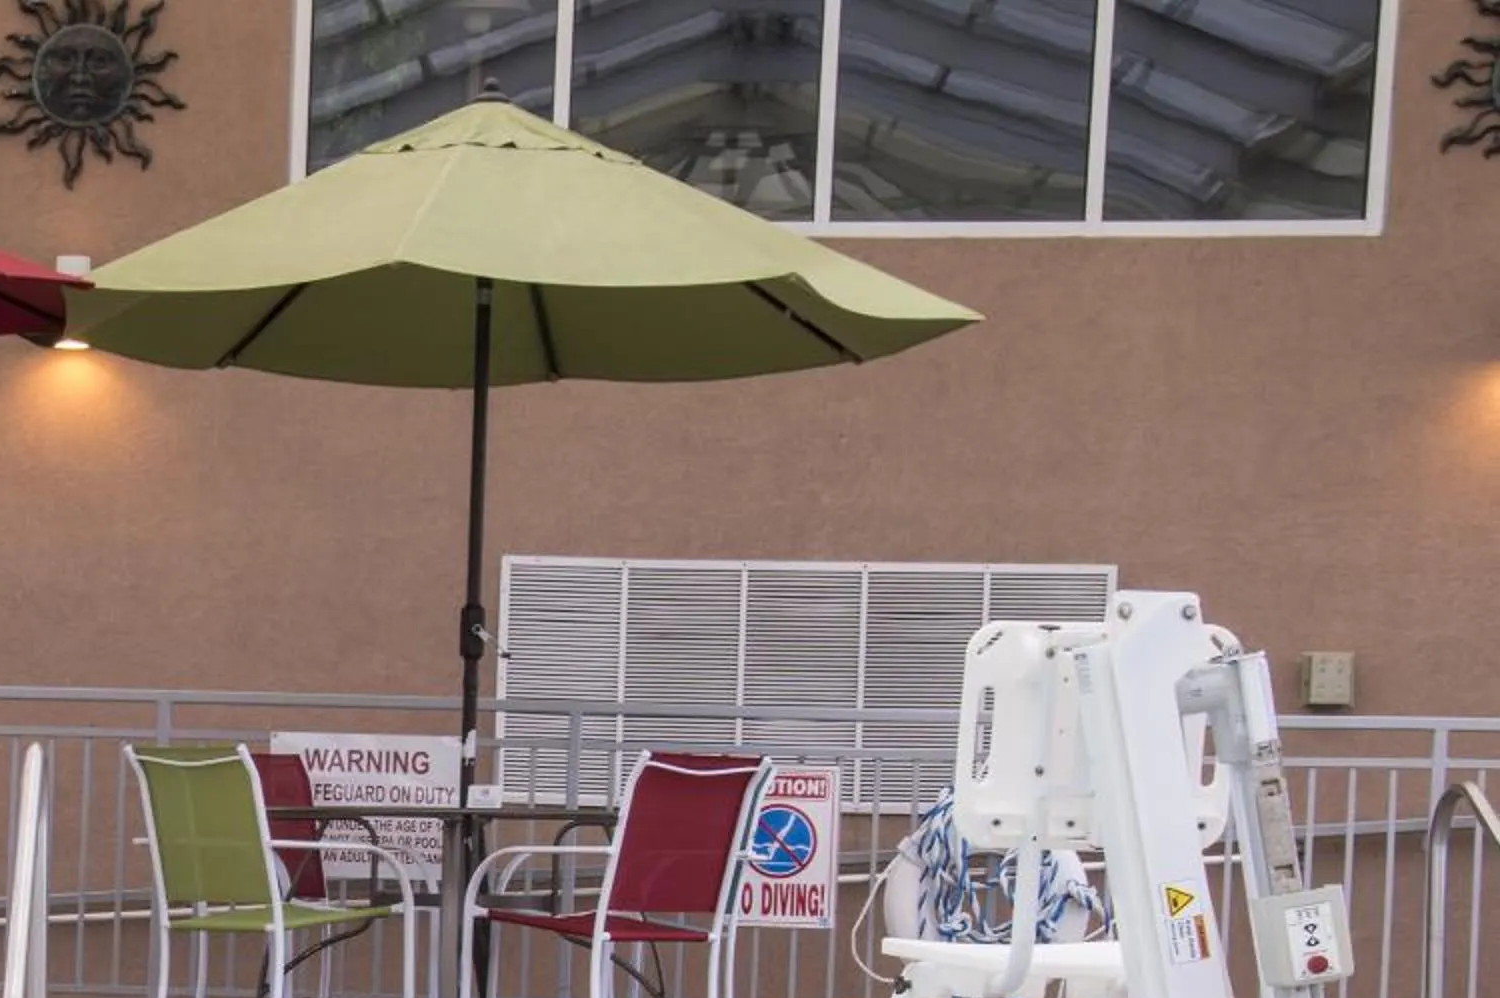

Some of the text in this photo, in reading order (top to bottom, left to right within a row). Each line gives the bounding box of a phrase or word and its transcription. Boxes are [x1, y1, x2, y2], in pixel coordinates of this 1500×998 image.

[305, 748, 430, 775] WARNING
[314, 783, 455, 806] FEGUARD ON DUTY
[766, 778, 825, 796] UTION!
[396, 820, 416, 833] AGE
[741, 881, 825, 917] O DIVING!
